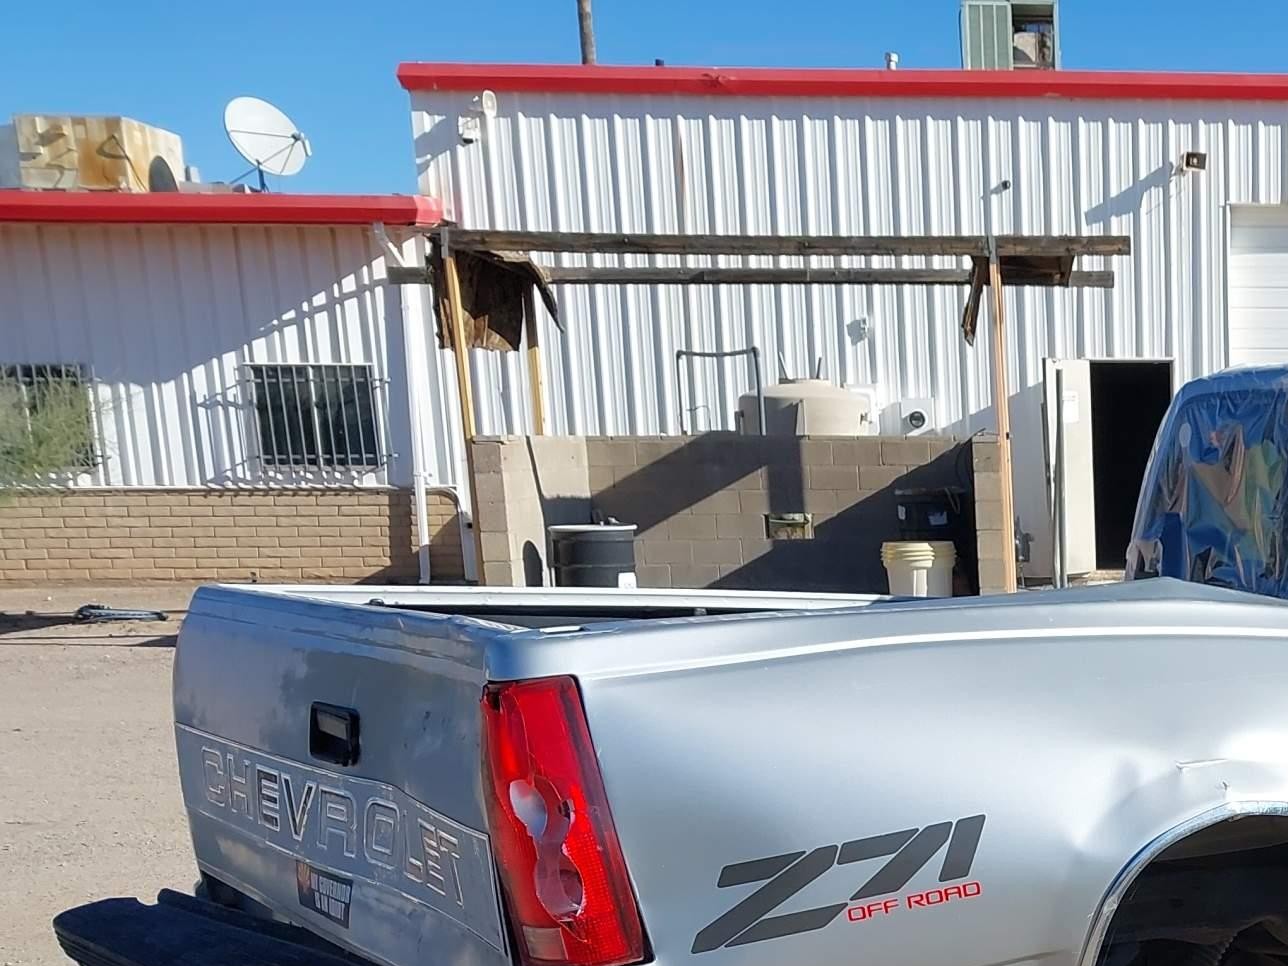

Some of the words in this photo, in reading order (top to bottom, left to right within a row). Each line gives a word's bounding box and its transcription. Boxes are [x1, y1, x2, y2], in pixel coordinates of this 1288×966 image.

[200, 745, 464, 908] CHEVROLET
[690, 813, 986, 954] Z71
[847, 899, 899, 922] OFF
[906, 881, 982, 909] ROAD
